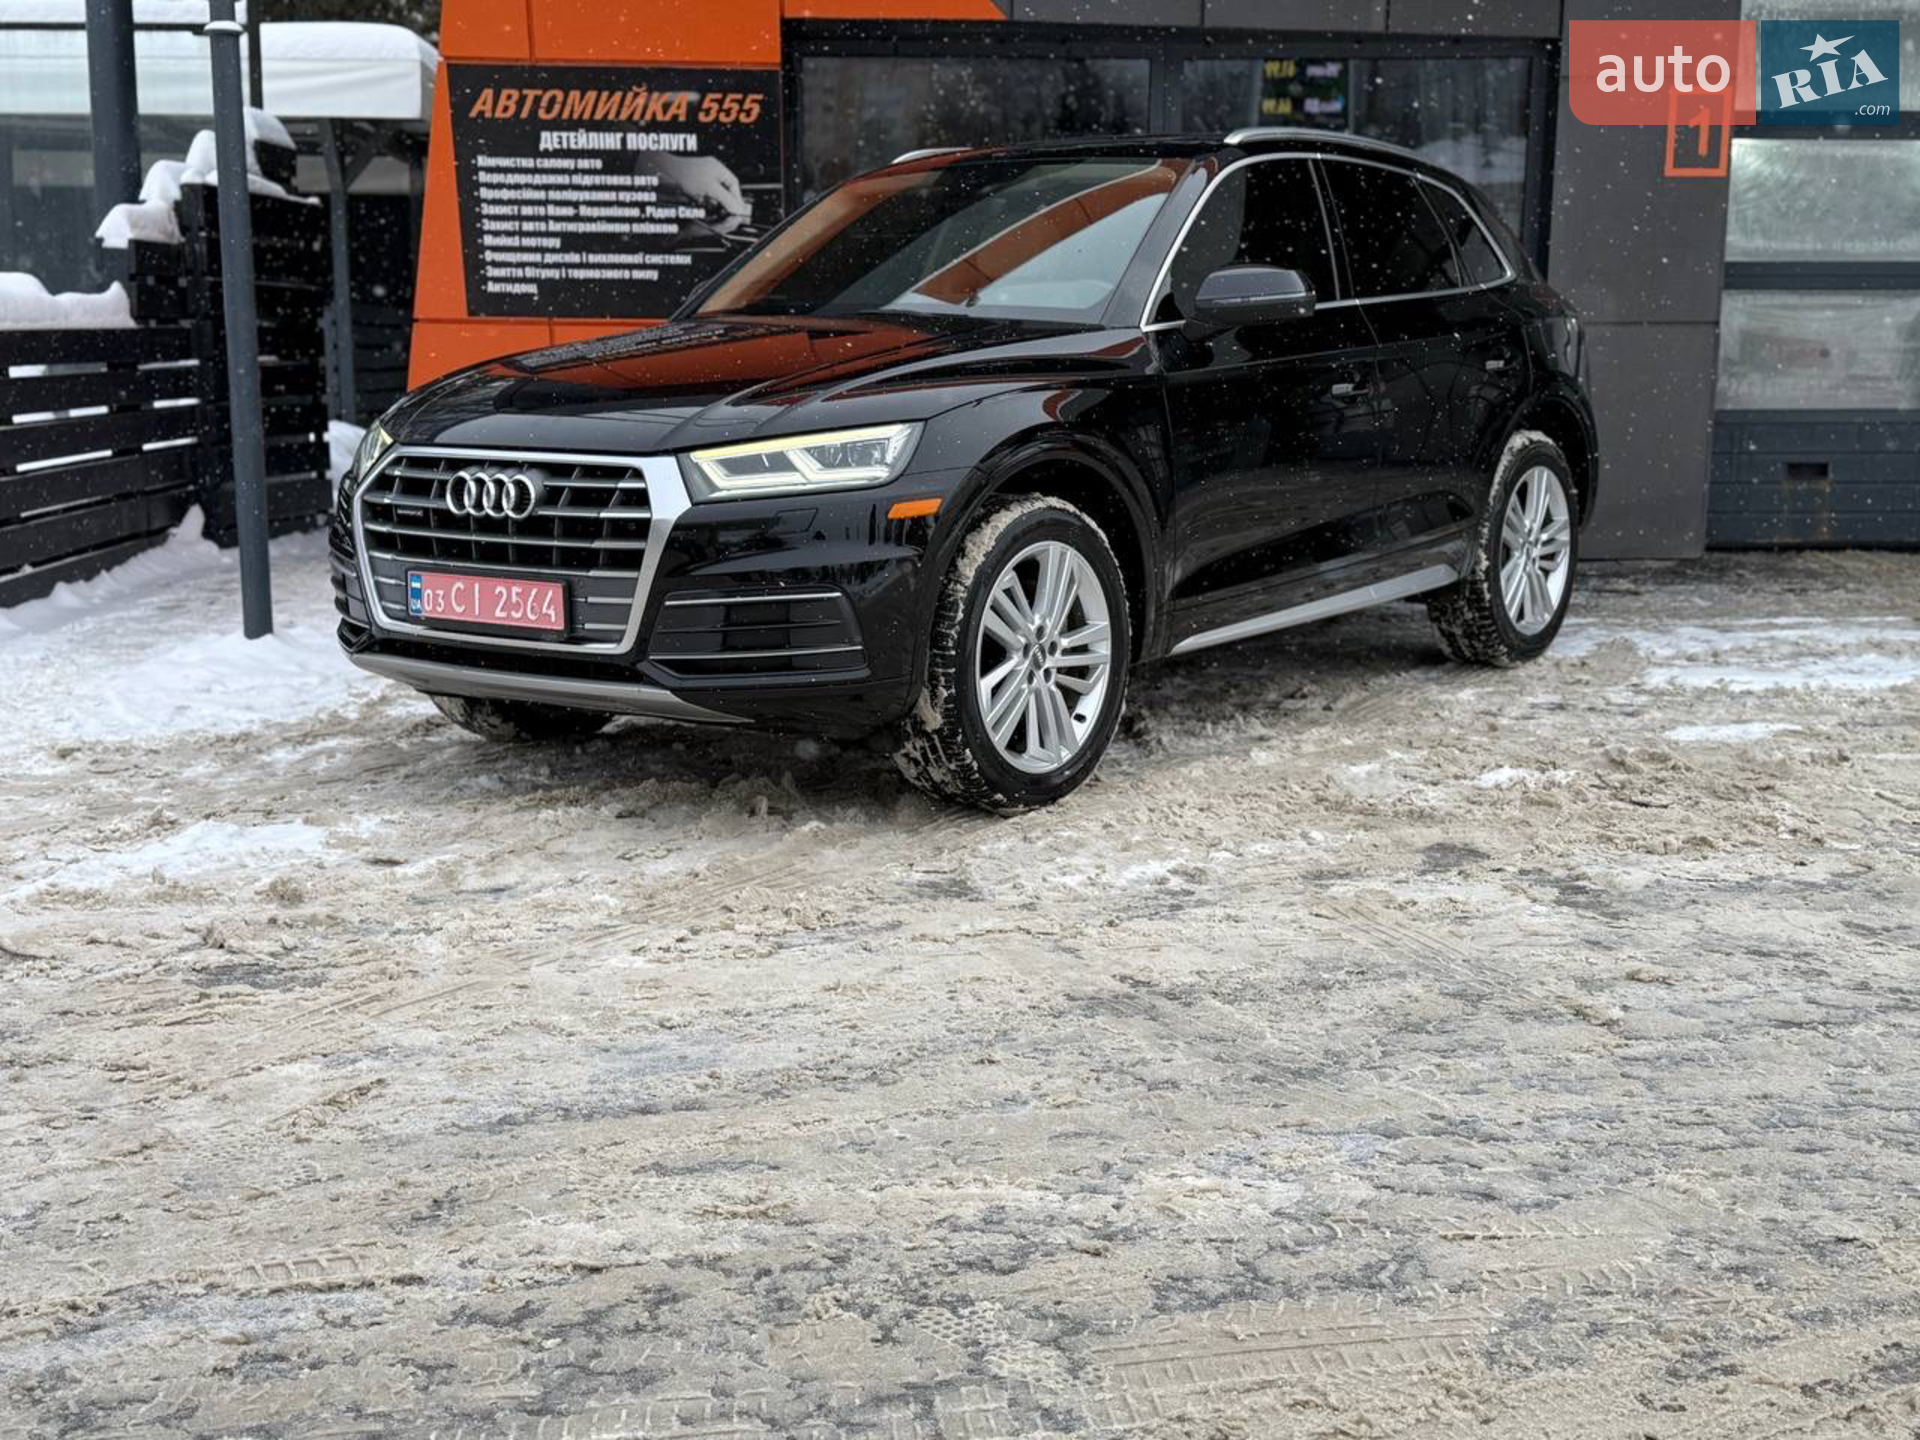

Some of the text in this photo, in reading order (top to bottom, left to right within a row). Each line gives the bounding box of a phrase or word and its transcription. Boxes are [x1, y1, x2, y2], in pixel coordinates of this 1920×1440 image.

[468, 86, 764, 123] АВТОМИЙКА 555
[539, 129, 698, 152] ДЕТЕЙЛІНГ ПОСЛУГИ
[576, 158, 603, 170] авто
[494, 585, 556, 622] 2564
